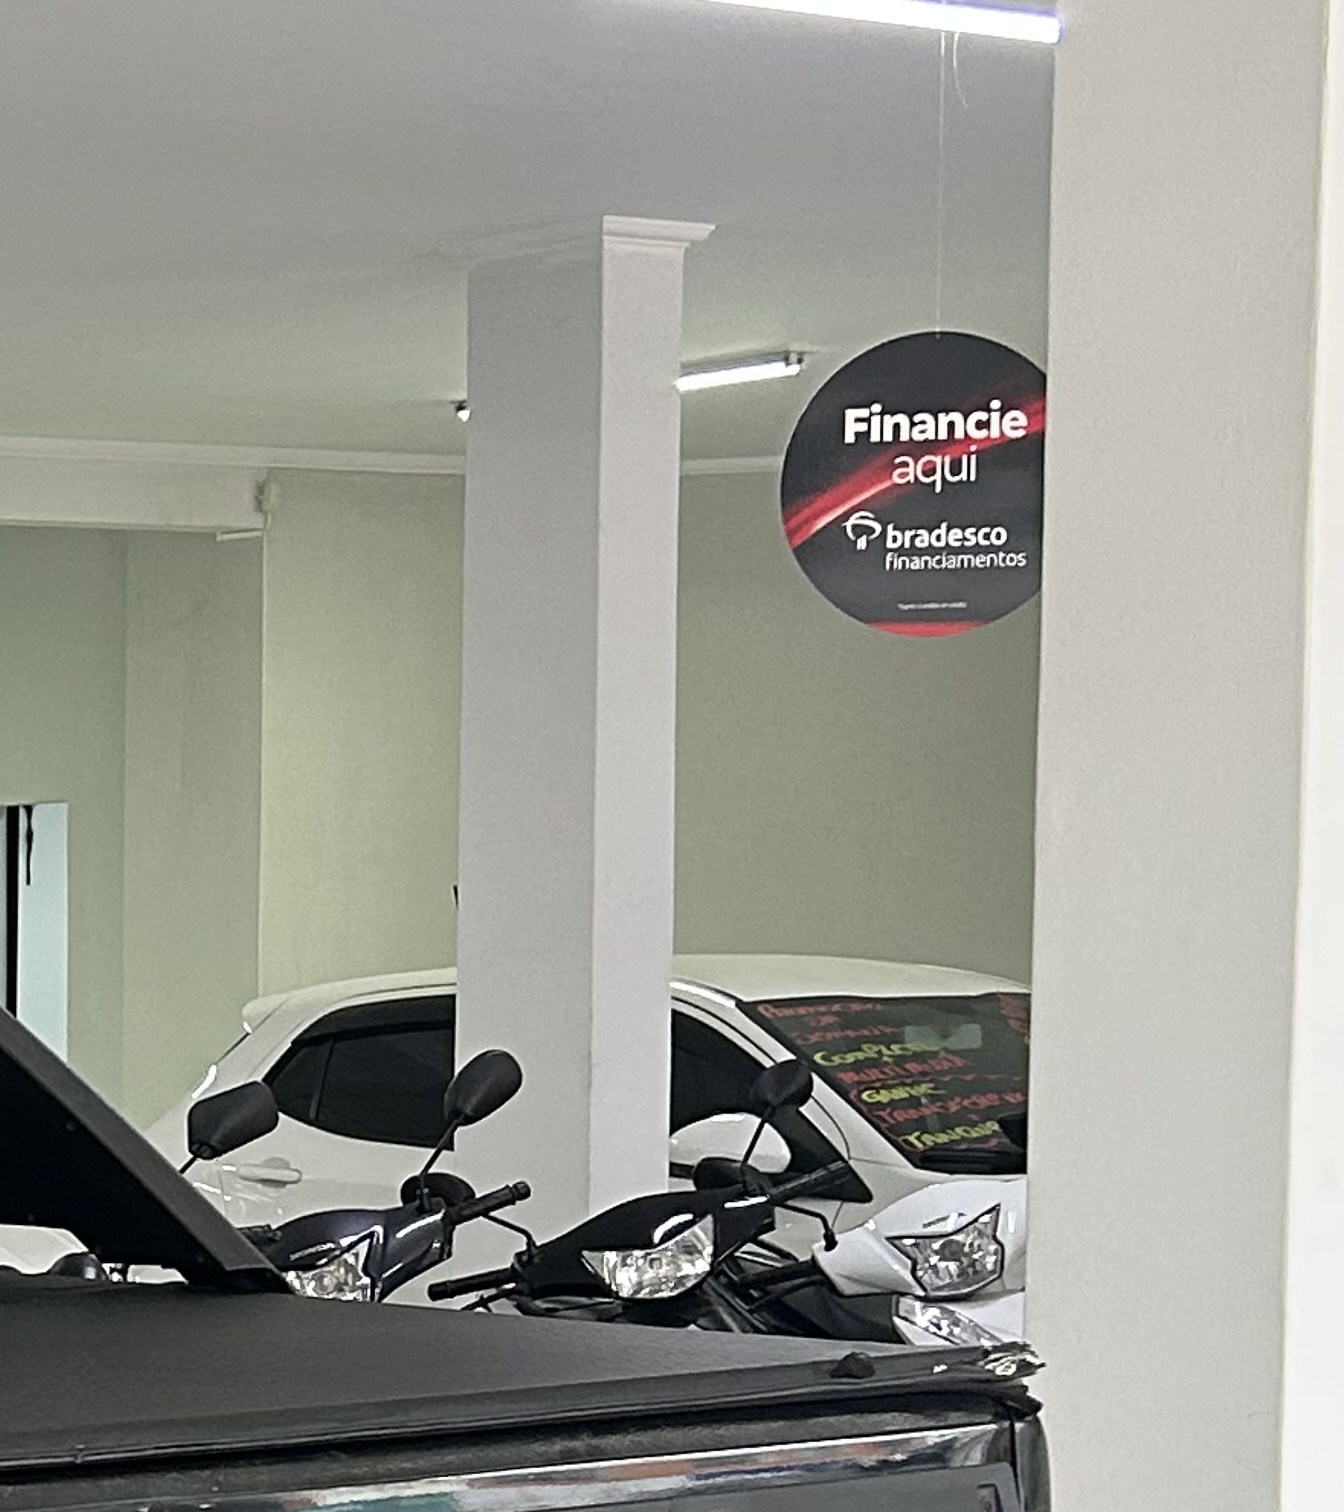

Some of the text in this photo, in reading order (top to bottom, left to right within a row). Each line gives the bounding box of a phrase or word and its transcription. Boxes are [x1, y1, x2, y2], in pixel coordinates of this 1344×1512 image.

[844, 400, 1028, 444] Financie
[891, 445, 978, 493] aqui
[885, 522, 1008, 548] bradesco
[885, 551, 1028, 570] financiamentos
